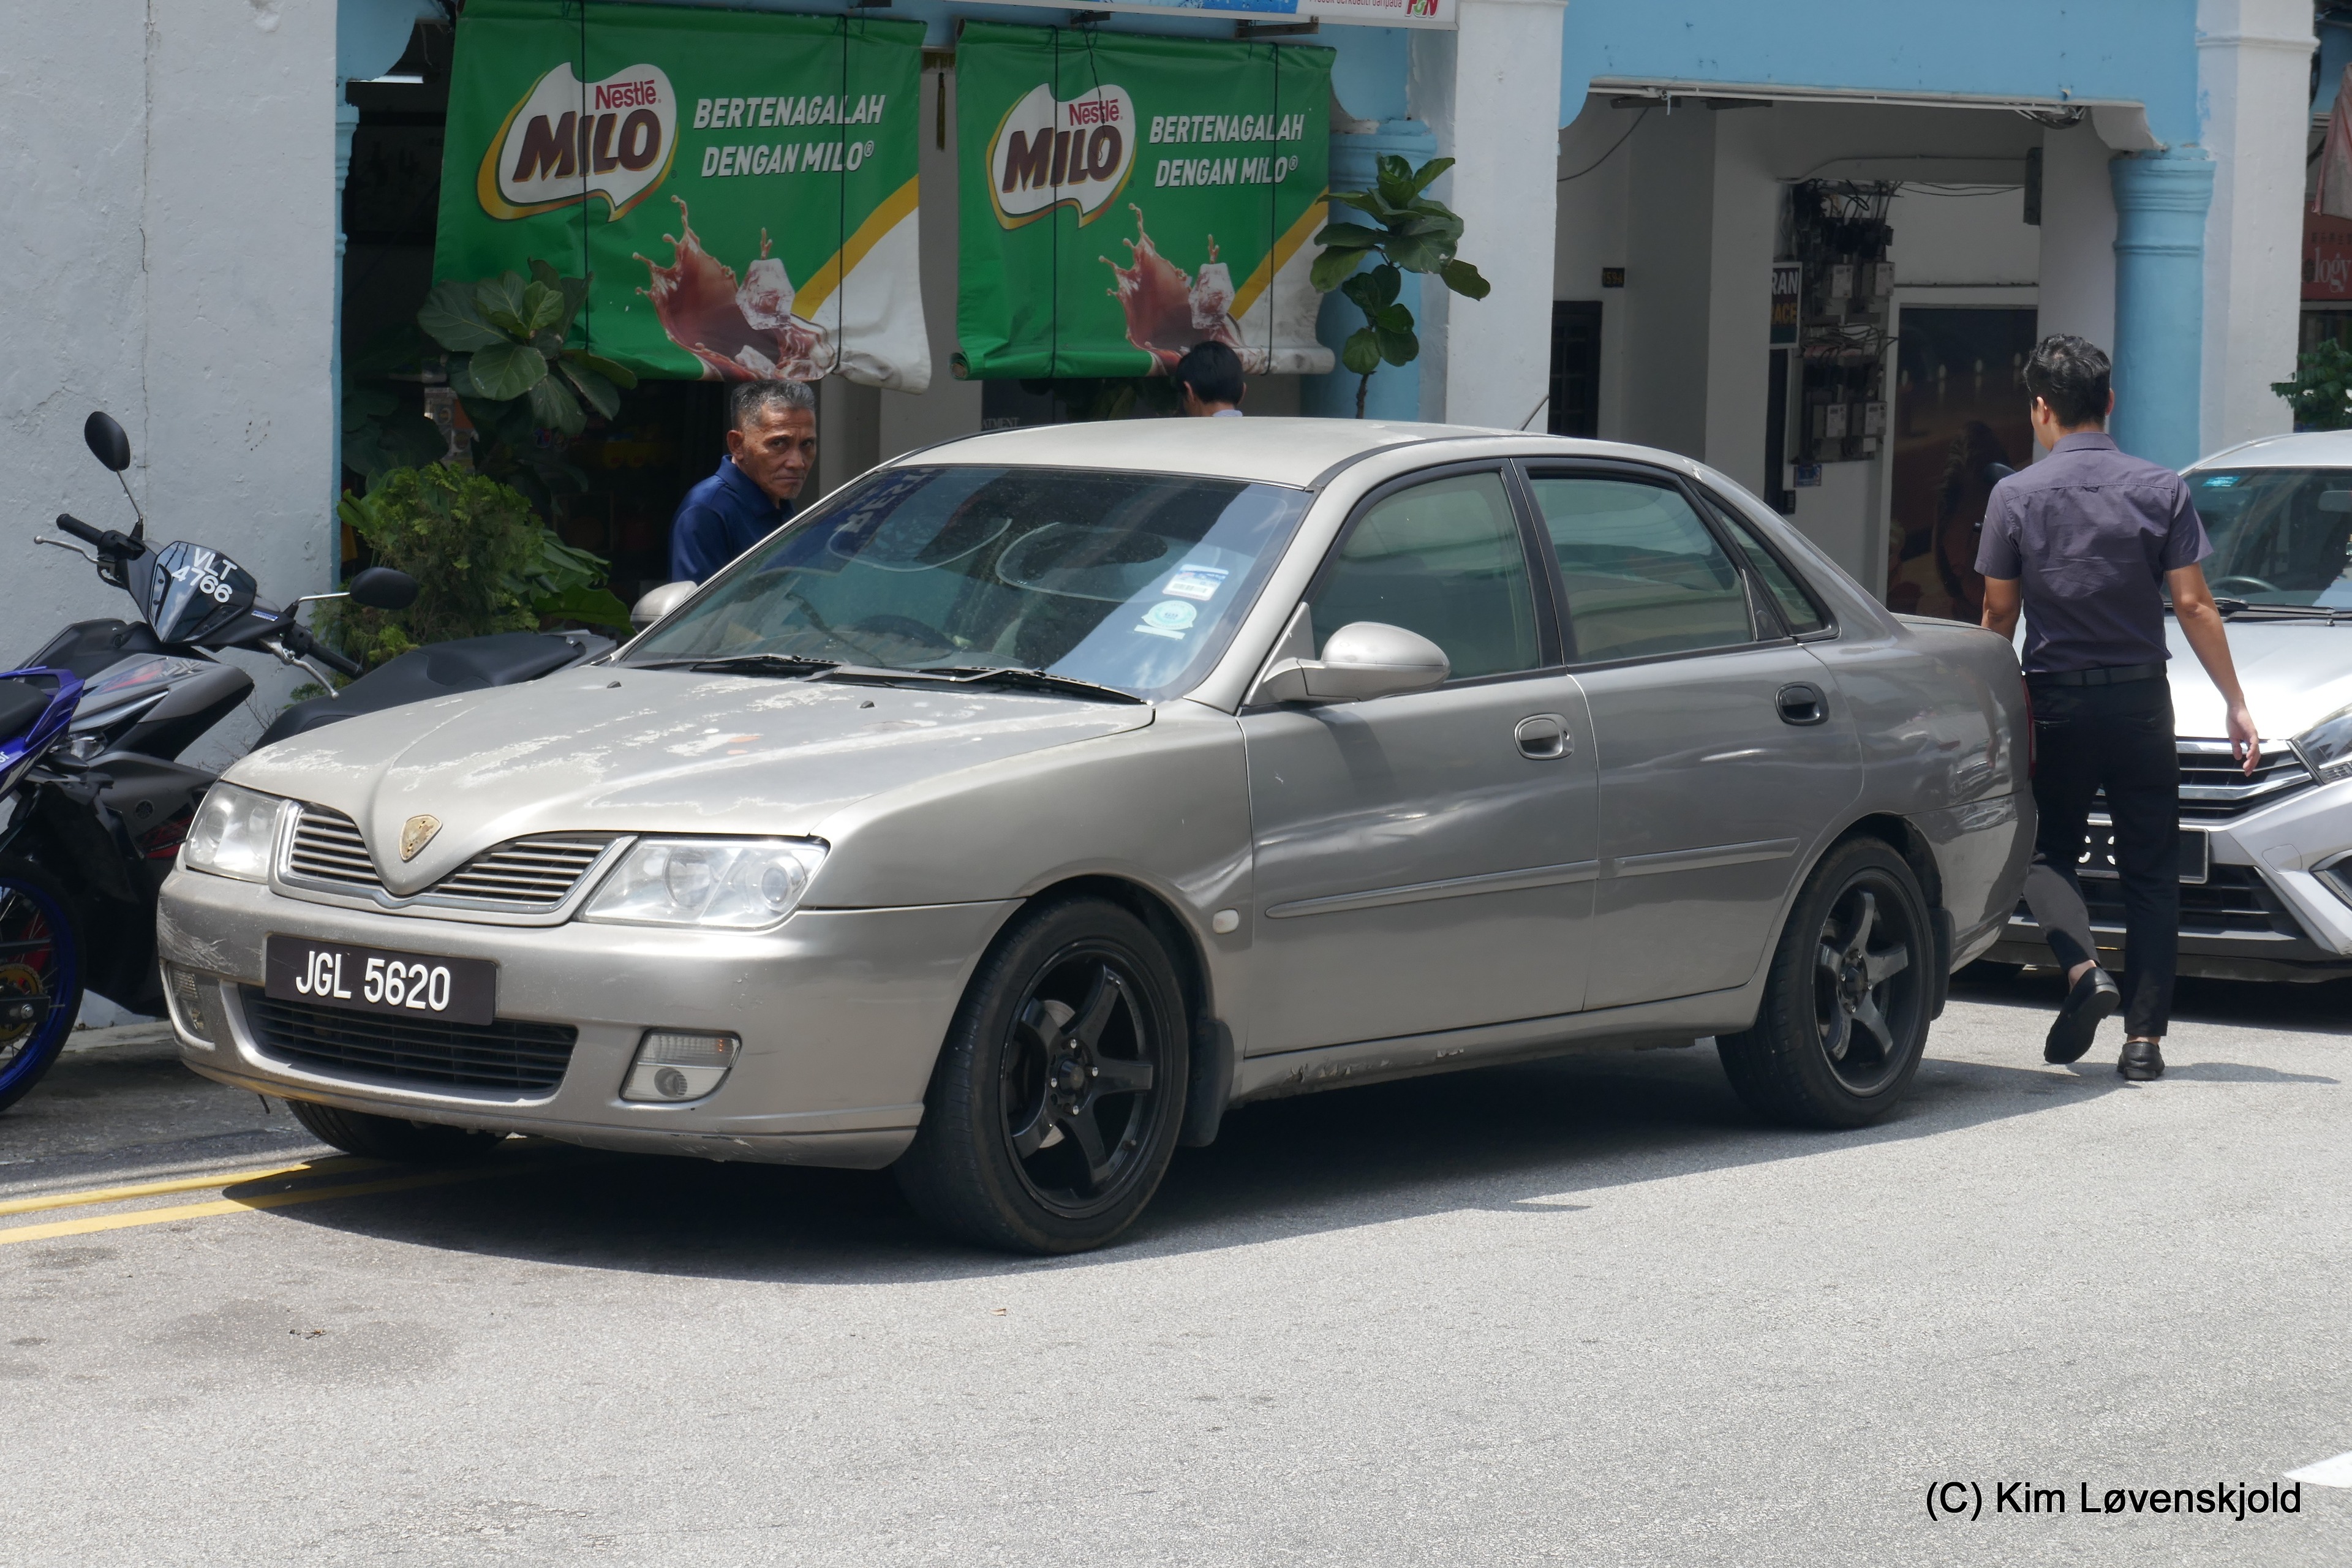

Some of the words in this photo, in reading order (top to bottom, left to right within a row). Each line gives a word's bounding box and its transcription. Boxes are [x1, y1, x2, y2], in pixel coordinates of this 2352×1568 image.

[595, 79, 657, 110] Nestlé
[693, 94, 886, 129] BERTENAGALAH
[512, 108, 662, 183] MILO
[1148, 114, 1305, 143] BERTENAGALAH
[701, 143, 801, 178] DENGAN
[1001, 124, 1123, 194] MILO
[1154, 157, 1238, 187] DENGAN
[1770, 302, 1797, 325] ACE
[193, 547, 238, 581] VLT
[171, 565, 233, 603] 4766
[296, 951, 352, 1000] JGL
[364, 957, 451, 1011] 5620
